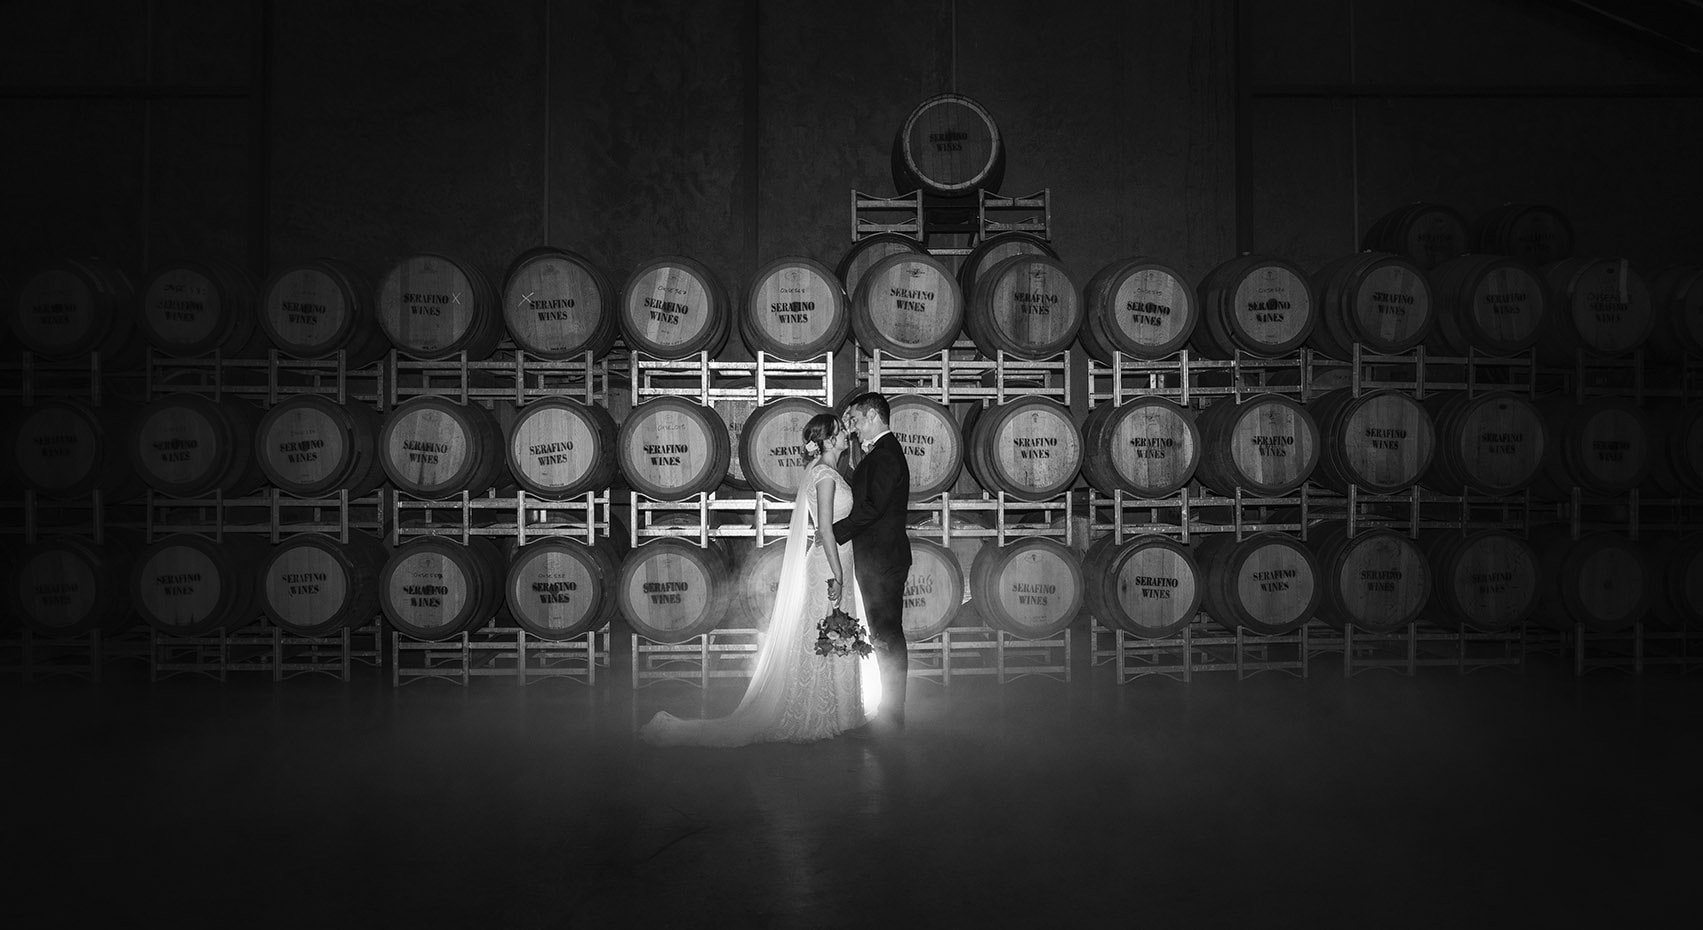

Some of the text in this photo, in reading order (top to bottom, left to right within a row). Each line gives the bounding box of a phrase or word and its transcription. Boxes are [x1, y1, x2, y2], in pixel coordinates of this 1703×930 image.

[403, 293, 449, 305] SERAFINO
[890, 287, 934, 301] SERAFINO
[1014, 293, 1058, 304] SERAFINO
[1372, 292, 1414, 305] SERAFINO
[282, 301, 326, 314] SERAFINO
[529, 299, 575, 310] SERAFINO
[644, 297, 689, 315] SERAFINO
[771, 301, 815, 313] SERAFINO
[896, 301, 925, 313] WINES
[1021, 304, 1050, 315] WINES
[1126, 301, 1170, 315] SERAFINO
[1377, 304, 1405, 316] WINES
[411, 306, 441, 316] WINES
[538, 310, 568, 321] WINES
[289, 314, 318, 325] WINES
[650, 310, 679, 325] WINES
[779, 313, 808, 324] WINES
[1132, 314, 1161, 327] WINES
[1256, 312, 1284, 323] WINES
[895, 432, 934, 445] ERAFINO
[1365, 428, 1407, 439] SERAFINO
[280, 439, 324, 452] SERAFINO
[1013, 438, 1057, 448] SERAFINO
[1130, 438, 1173, 448] SERAFINO
[1252, 436, 1294, 446] SERAFINO
[1372, 440, 1399, 450] WINES
[403, 440, 448, 454] SERAFINO
[529, 441, 574, 455] SERAFINO
[644, 444, 688, 454] SERAFINO
[903, 446, 925, 457] INES
[1259, 446, 1286, 457] WINES
[288, 452, 318, 463] WINES
[409, 453, 439, 464] WINES
[1021, 450, 1050, 459] WINES
[1136, 449, 1165, 459] WINES
[538, 454, 568, 466] WINES
[651, 456, 681, 466] WINES
[778, 458, 803, 468] WINE
[156, 573, 201, 585] SERAFINO
[282, 573, 327, 583] SERAFINO
[1253, 570, 1296, 581] SERAFINO
[1360, 569, 1402, 581] SERAFINO
[532, 581, 577, 592] SERAFINO
[643, 582, 688, 593] SERAFINO
[1135, 576, 1179, 588] SERAFINO
[1261, 582, 1289, 592] WINES
[1367, 581, 1395, 592] WINES
[164, 586, 194, 595] WINES
[290, 584, 319, 596] WINES
[403, 585, 448, 596] SERAFINO
[903, 584, 932, 597] AFINO
[1012, 583, 1056, 595] SERAFINO
[1142, 588, 1170, 600] WINES
[410, 597, 441, 608] WINES
[540, 593, 569, 604] WINES
[651, 593, 681, 605] WINES
[904, 597, 926, 608] INES
[1018, 595, 1048, 606] WINES
